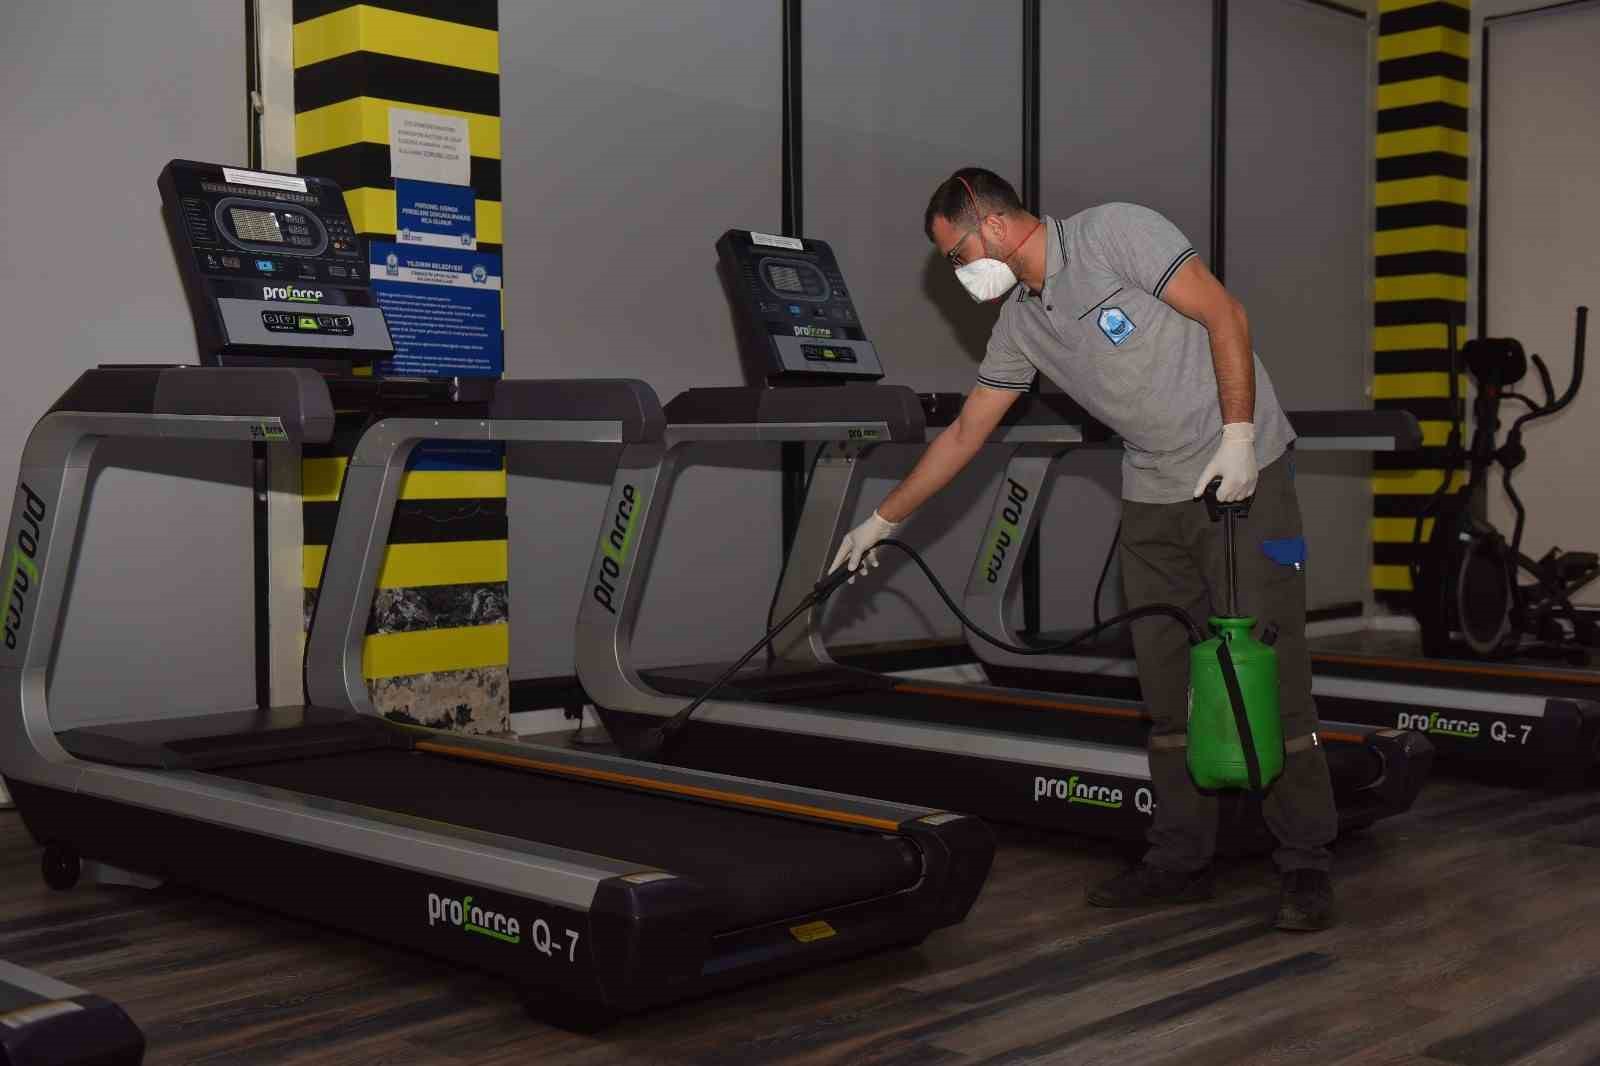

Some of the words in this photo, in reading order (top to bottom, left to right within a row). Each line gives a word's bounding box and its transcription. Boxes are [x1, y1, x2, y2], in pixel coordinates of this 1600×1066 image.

[263, 285, 323, 302] proforce
[1397, 712, 1480, 738] proforce
[1490, 720, 1533, 745] Q-7
[1034, 776, 1122, 808] proforce
[428, 893, 520, 944] proforce
[532, 918, 580, 963] Q-7
